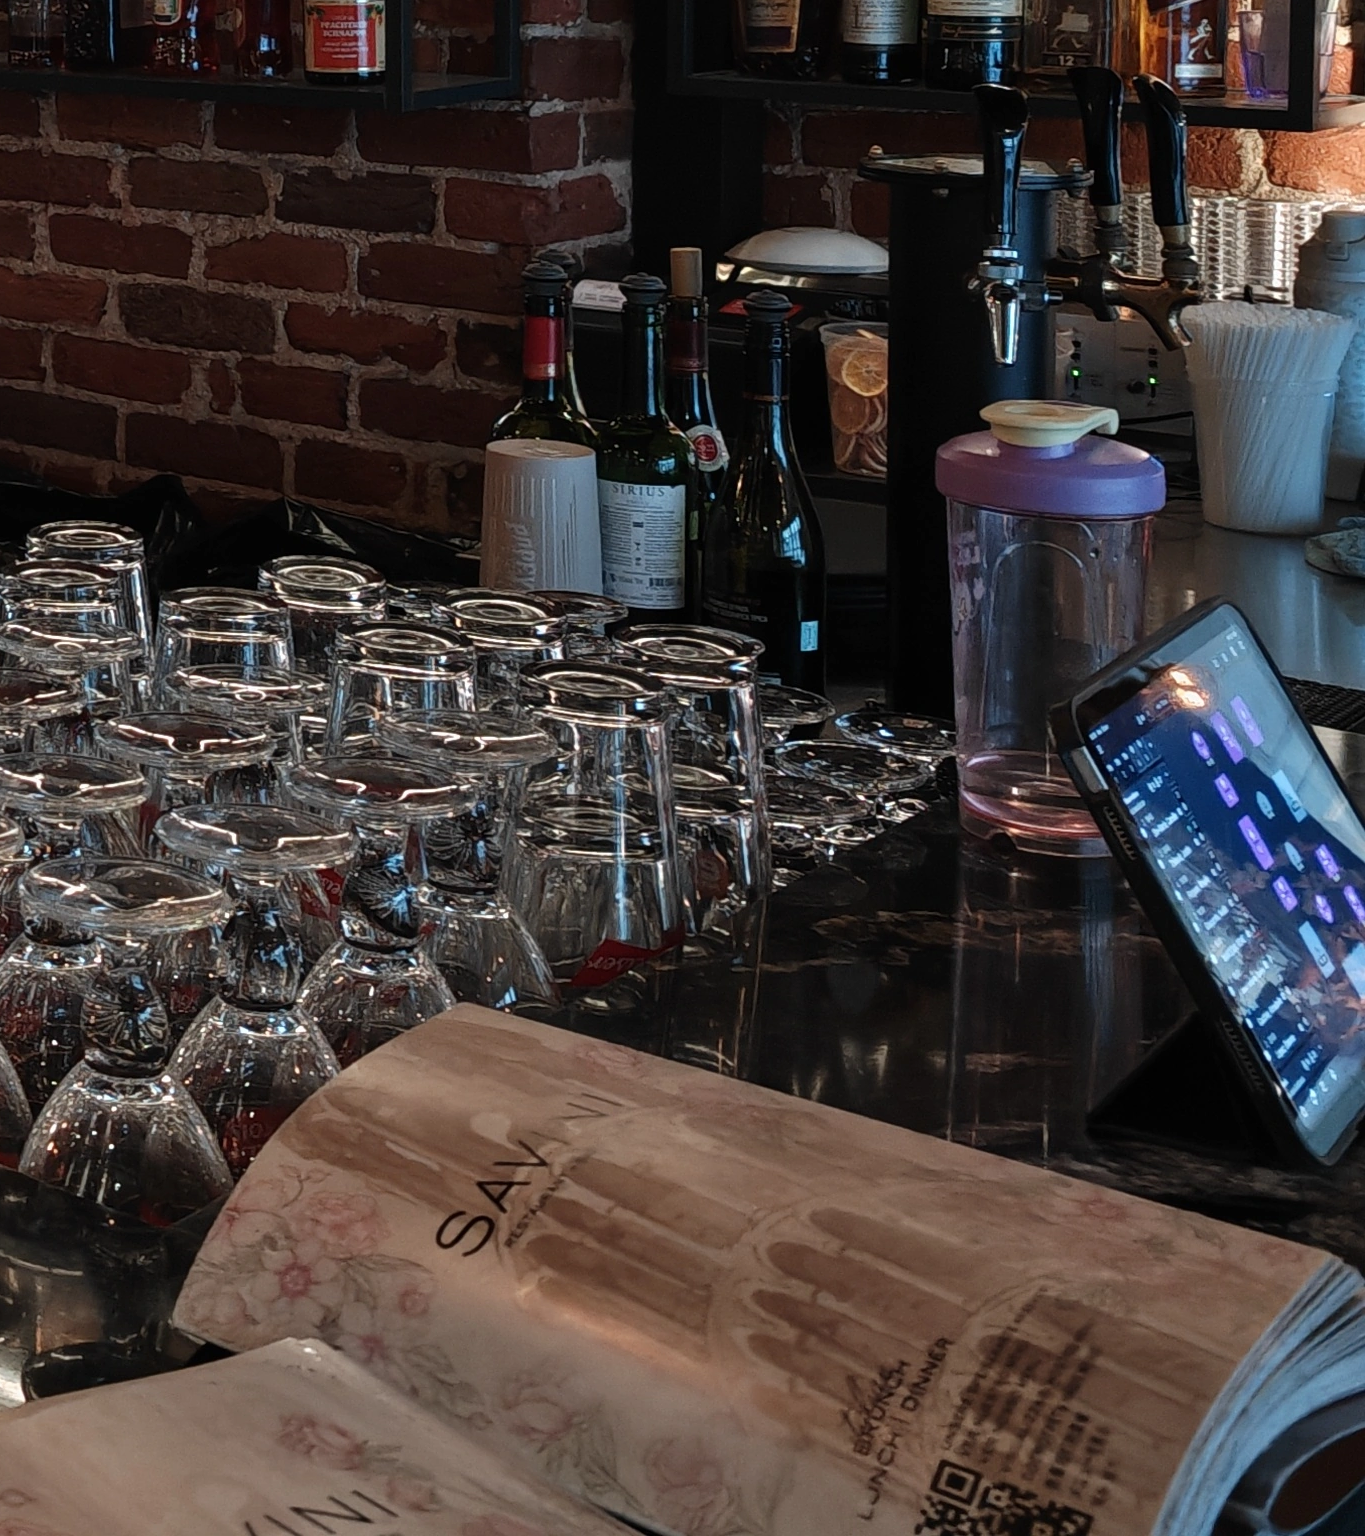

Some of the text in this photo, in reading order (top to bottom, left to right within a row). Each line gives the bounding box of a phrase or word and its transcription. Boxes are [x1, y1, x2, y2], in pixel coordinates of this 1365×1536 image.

[1058, 55, 1075, 66] 12
[611, 484, 666, 497] SIRIUS
[899, 1337, 956, 1412] DINNER
